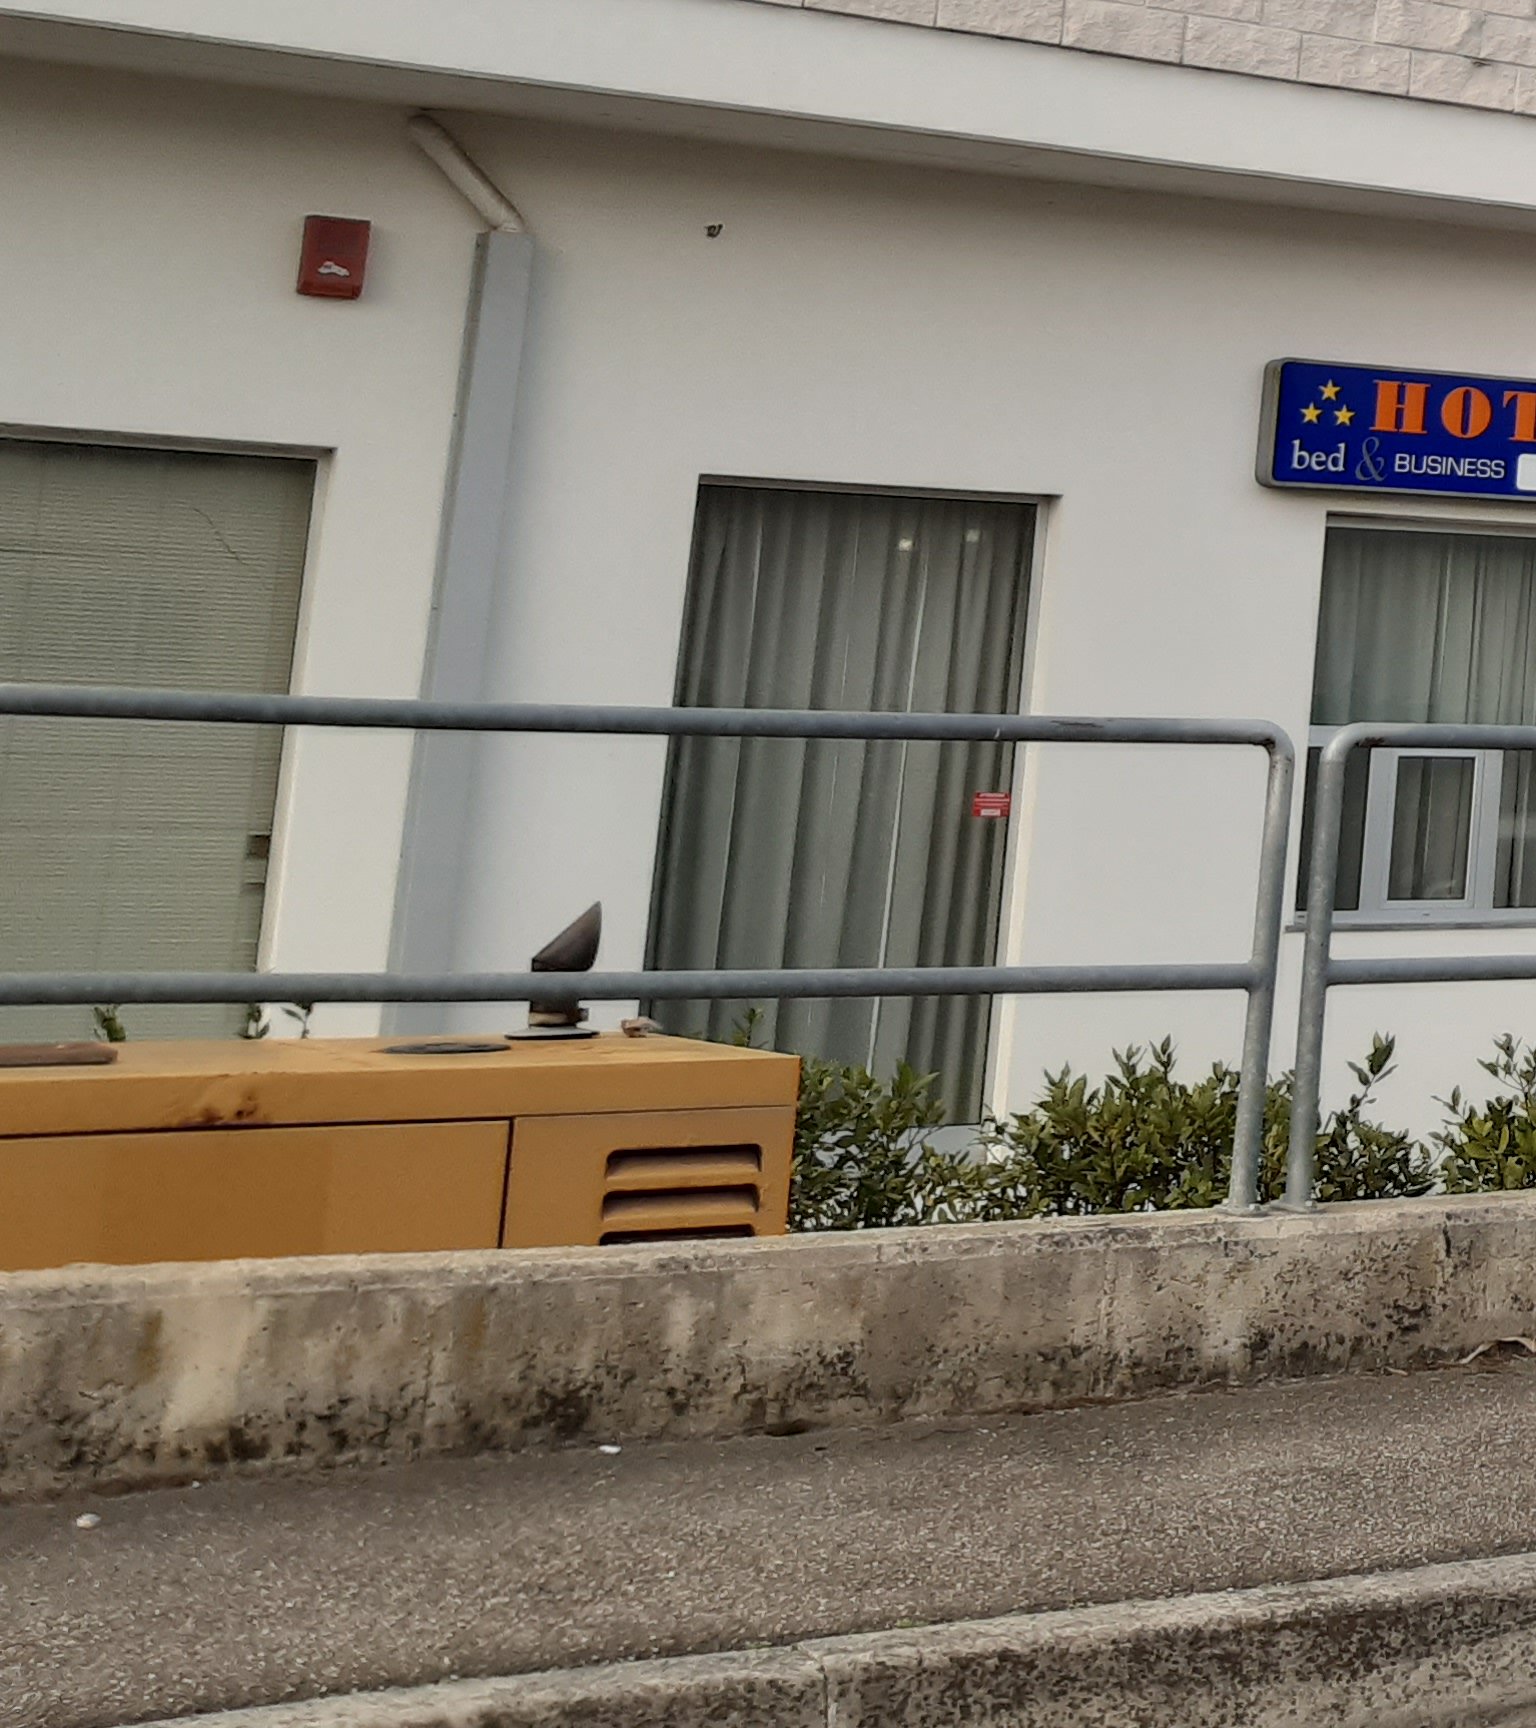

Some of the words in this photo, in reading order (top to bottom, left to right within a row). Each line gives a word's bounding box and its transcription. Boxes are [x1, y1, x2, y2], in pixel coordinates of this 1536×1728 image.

[1291, 439, 1345, 472] bed
[1355, 436, 1387, 482] &
[1394, 453, 1505, 479] BUSINESS
